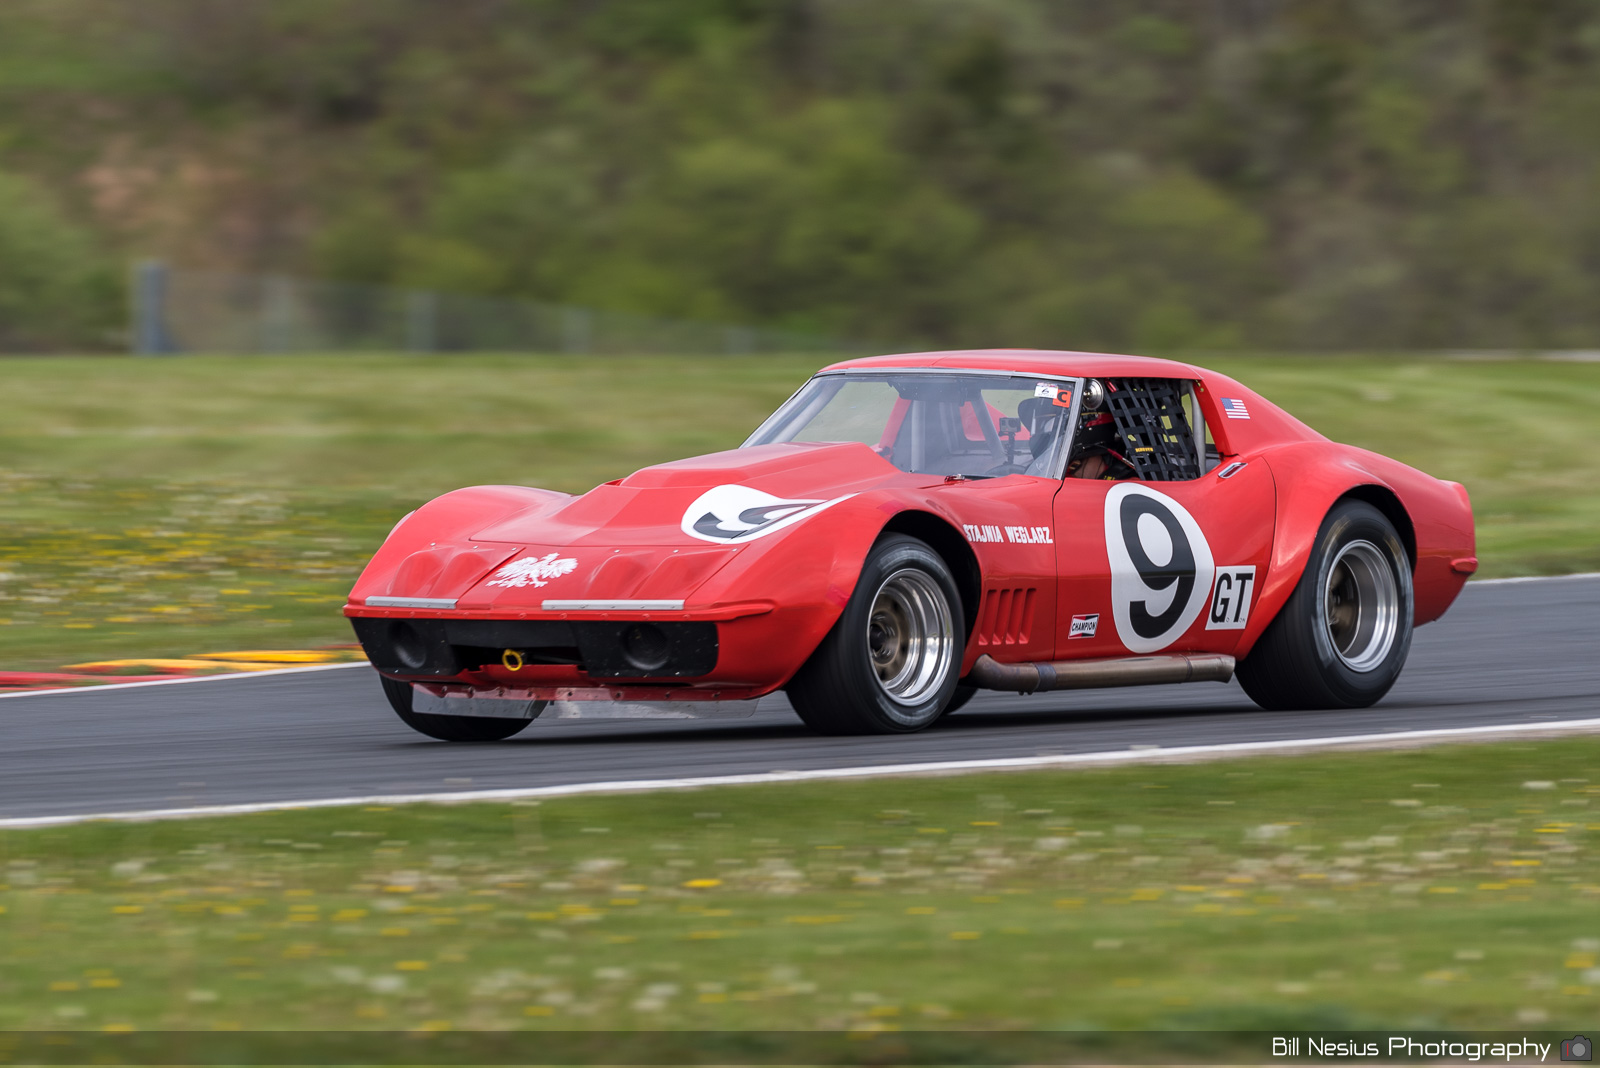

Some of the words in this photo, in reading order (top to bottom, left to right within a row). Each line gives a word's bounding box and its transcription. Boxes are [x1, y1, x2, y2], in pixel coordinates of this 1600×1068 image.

[1057, 391, 1068, 403] C
[962, 524, 1004, 543] STAJNIA
[1004, 525, 1054, 544] WEGLARZ
[1120, 493, 1197, 639] 9
[1211, 573, 1254, 623] GT
[1072, 621, 1097, 631] CHAMPION
